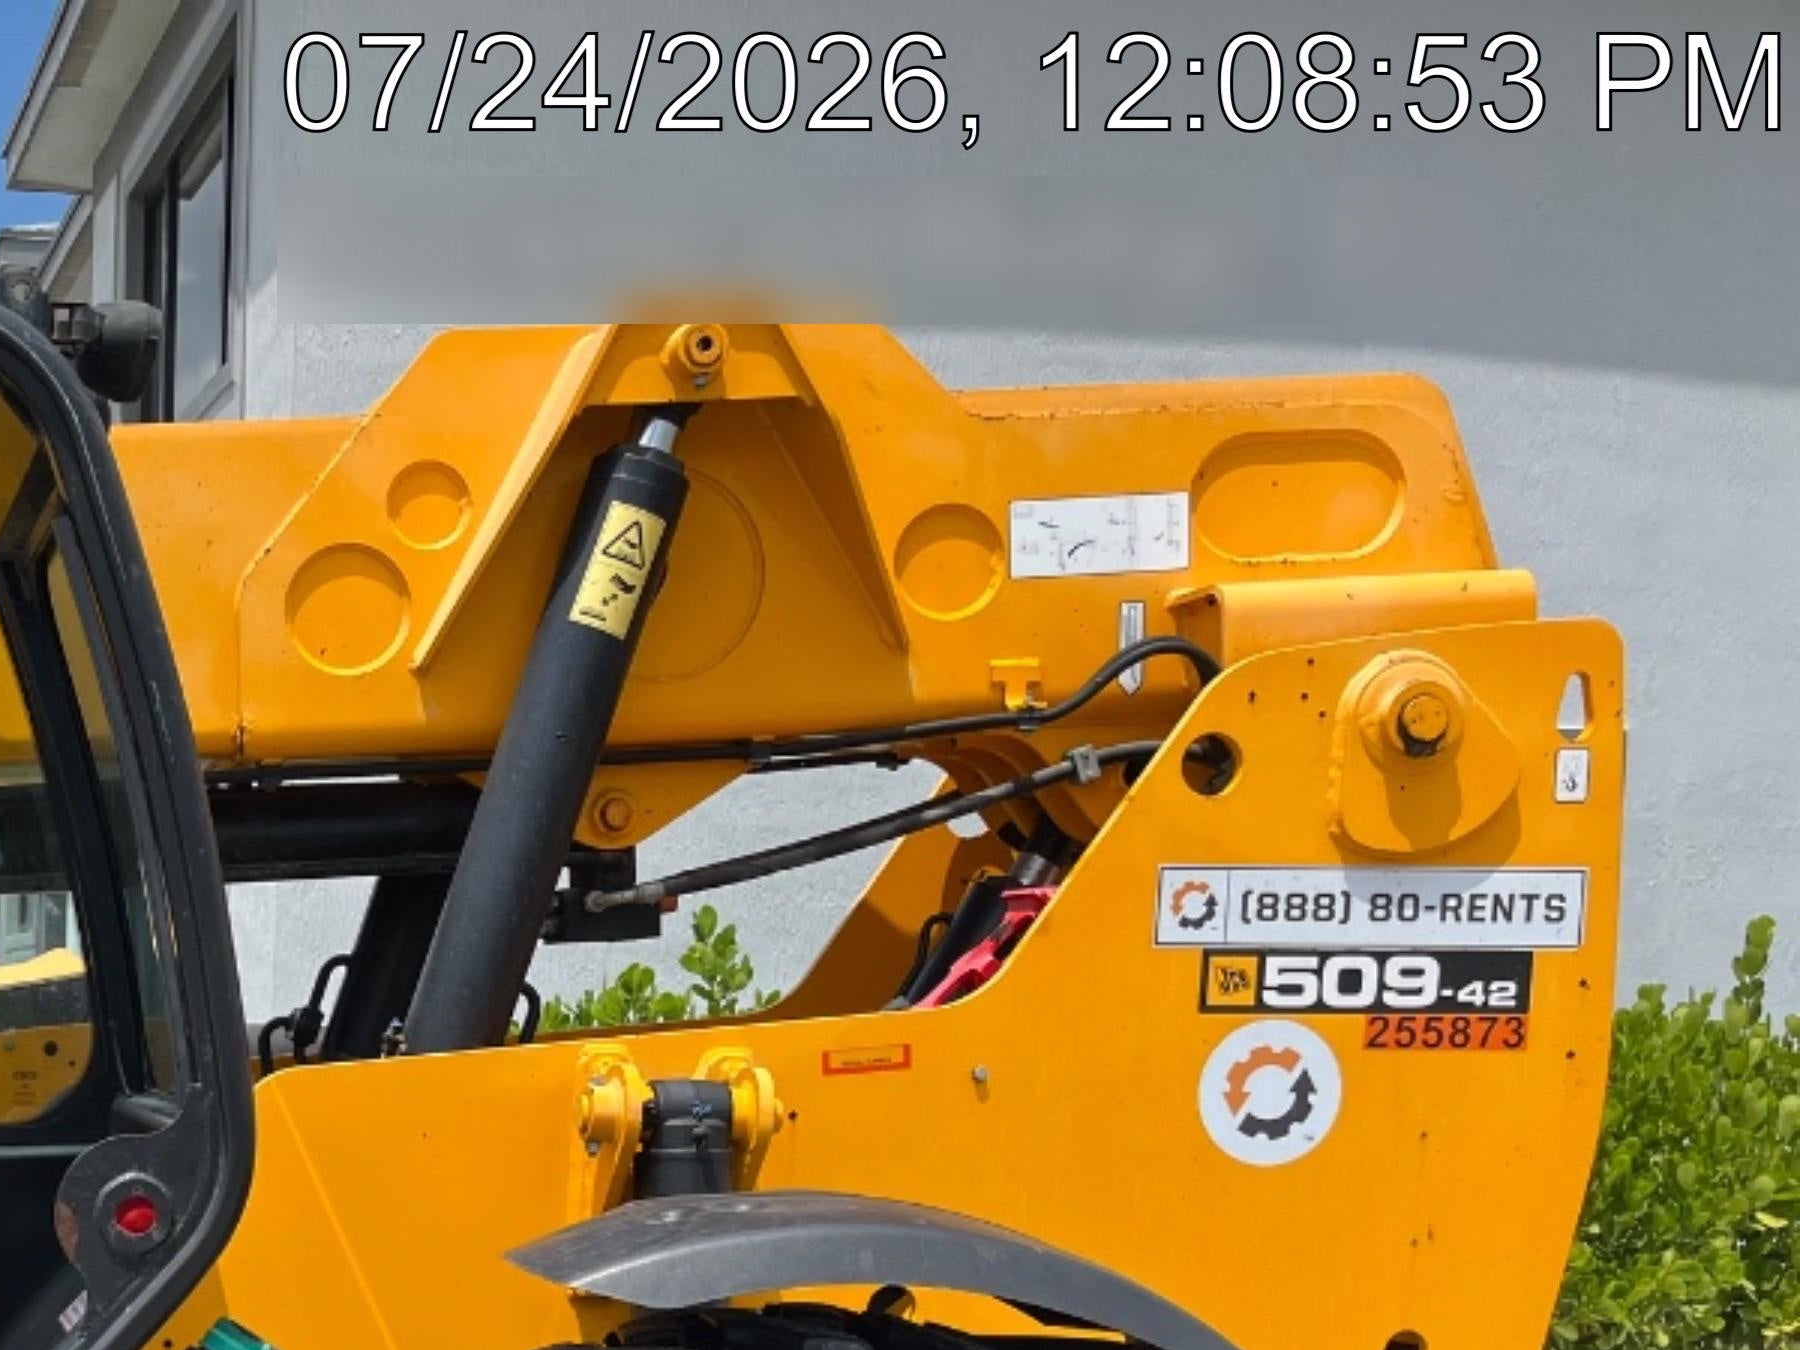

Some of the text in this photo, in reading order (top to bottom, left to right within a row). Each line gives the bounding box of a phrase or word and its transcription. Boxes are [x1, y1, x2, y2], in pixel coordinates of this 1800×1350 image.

[1241, 890, 1568, 925] (888) 80-RENTS
[1262, 954, 1517, 1008] 509-42
[1366, 1016, 1526, 1049] 255873
